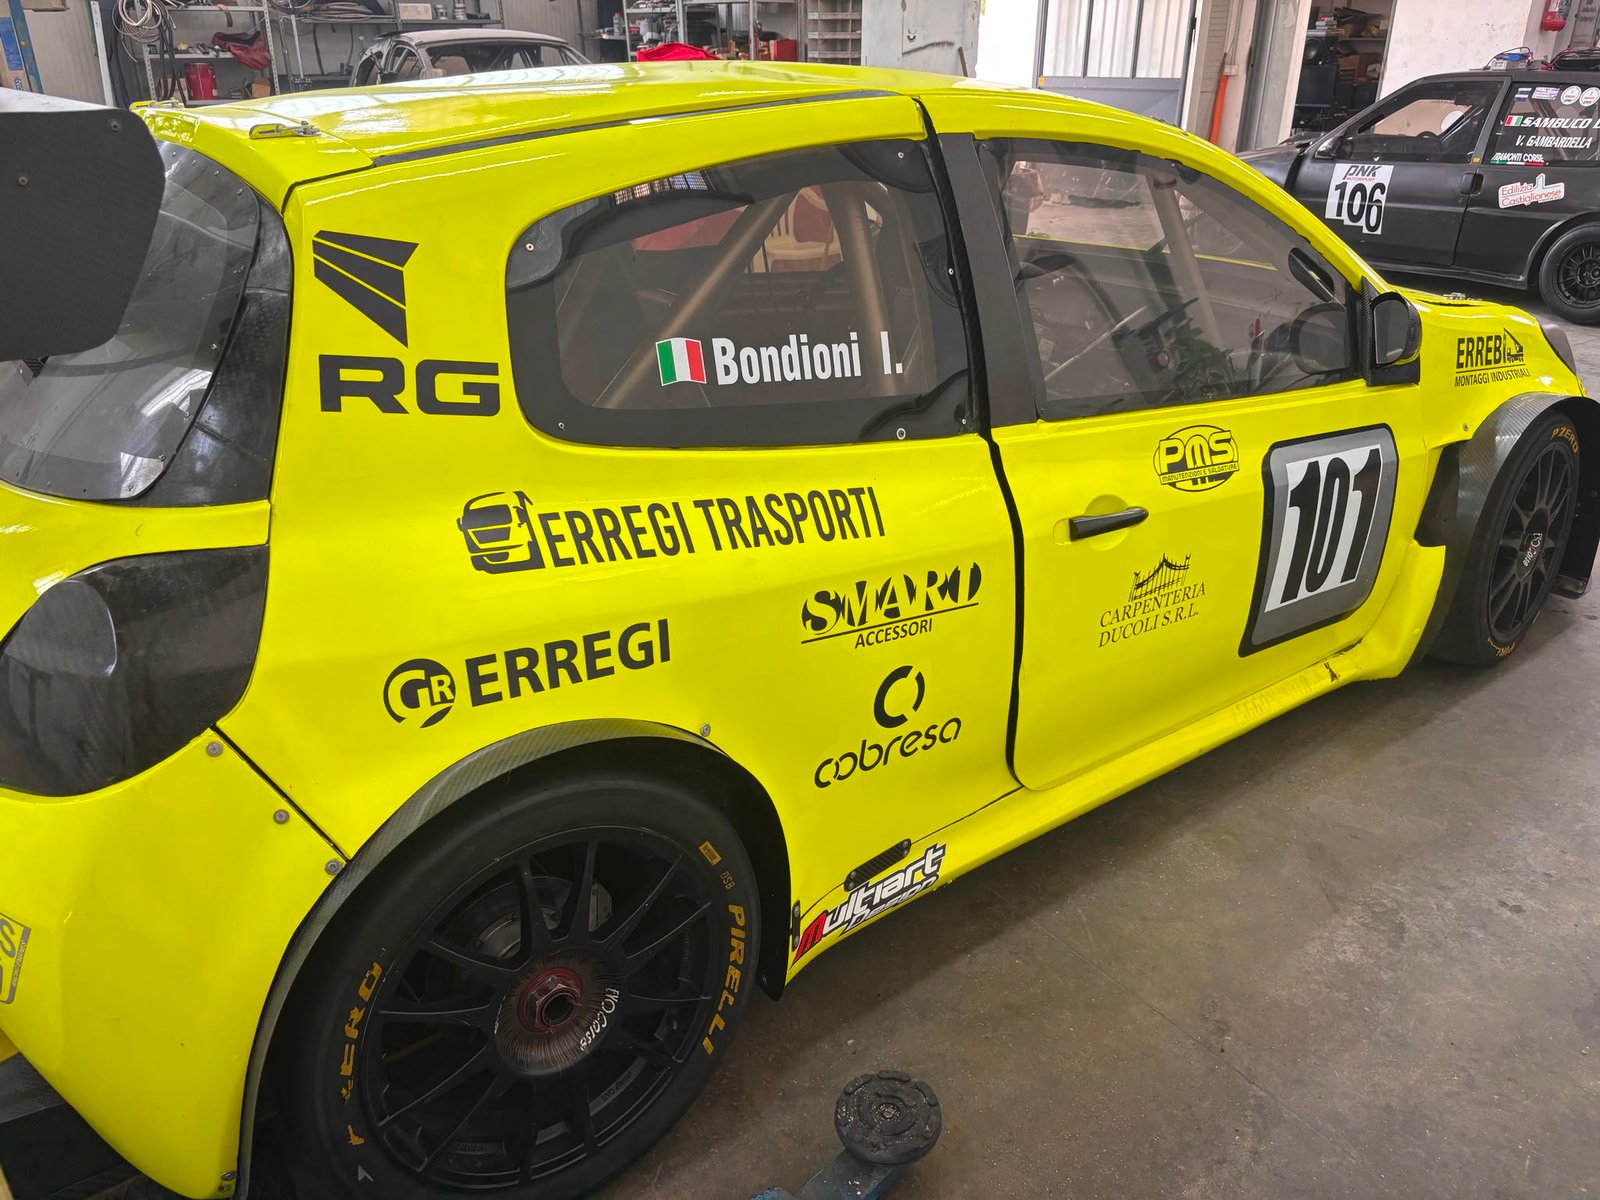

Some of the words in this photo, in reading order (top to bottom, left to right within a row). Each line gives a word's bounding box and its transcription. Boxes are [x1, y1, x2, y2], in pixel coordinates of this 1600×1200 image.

[1515, 135, 1524, 146] V.
[1526, 136, 1593, 148] GAMBARDELLA
[1521, 117, 1592, 128] SAMBUCO
[1522, 153, 1545, 163] CORSE
[1334, 181, 1386, 232] 106
[1502, 183, 1533, 196] Edilizia
[1502, 189, 1562, 206] Castiglionese
[711, 331, 862, 386] Bondioni
[880, 331, 904, 375] I.
[1454, 373, 1490, 388] MONTAGGI
[1491, 368, 1531, 382] INDUSTRIALI
[318, 354, 500, 416] RG
[1159, 430, 1235, 474] PMS
[538, 501, 695, 567] ERREGI
[693, 486, 885, 551] TRASPORTI
[1280, 448, 1382, 604] 101
[1098, 614, 1160, 647] DUCOLI
[1162, 603, 1199, 627] S.R.L.
[1100, 581, 1206, 627] CARPENTERIA
[855, 618, 933, 649] ACCESSORI
[465, 618, 671, 708] ERREGI
[814, 717, 962, 788] cobresa
[703, 904, 746, 1055] PIRELLI
